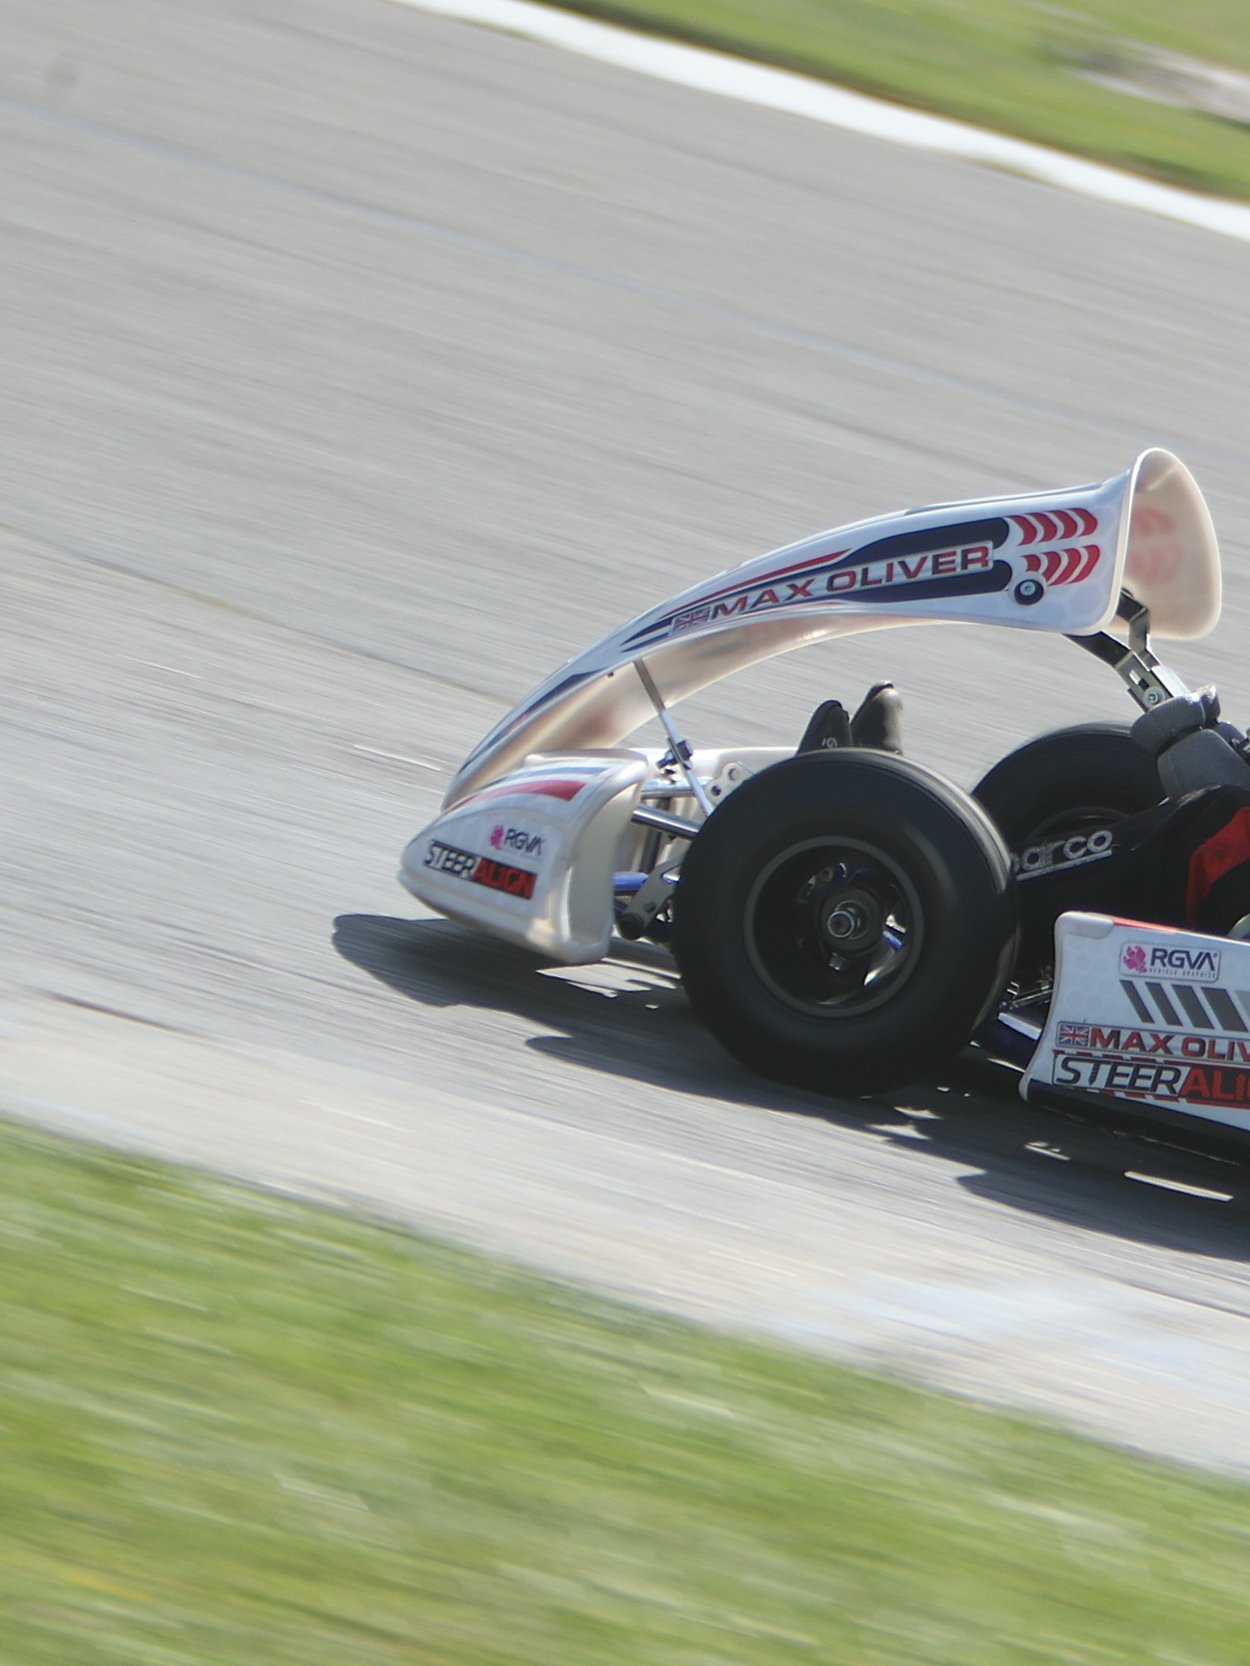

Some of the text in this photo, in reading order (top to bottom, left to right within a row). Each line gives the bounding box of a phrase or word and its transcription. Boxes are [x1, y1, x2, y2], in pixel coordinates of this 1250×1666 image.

[711, 545, 990, 621] MAX OLIVER
[503, 828, 542, 856] RGVA
[1008, 830, 1113, 876] arco
[423, 840, 537, 899] STEERALIGN
[1150, 947, 1215, 971] RGVA
[1089, 1028, 1176, 1055] MAX
